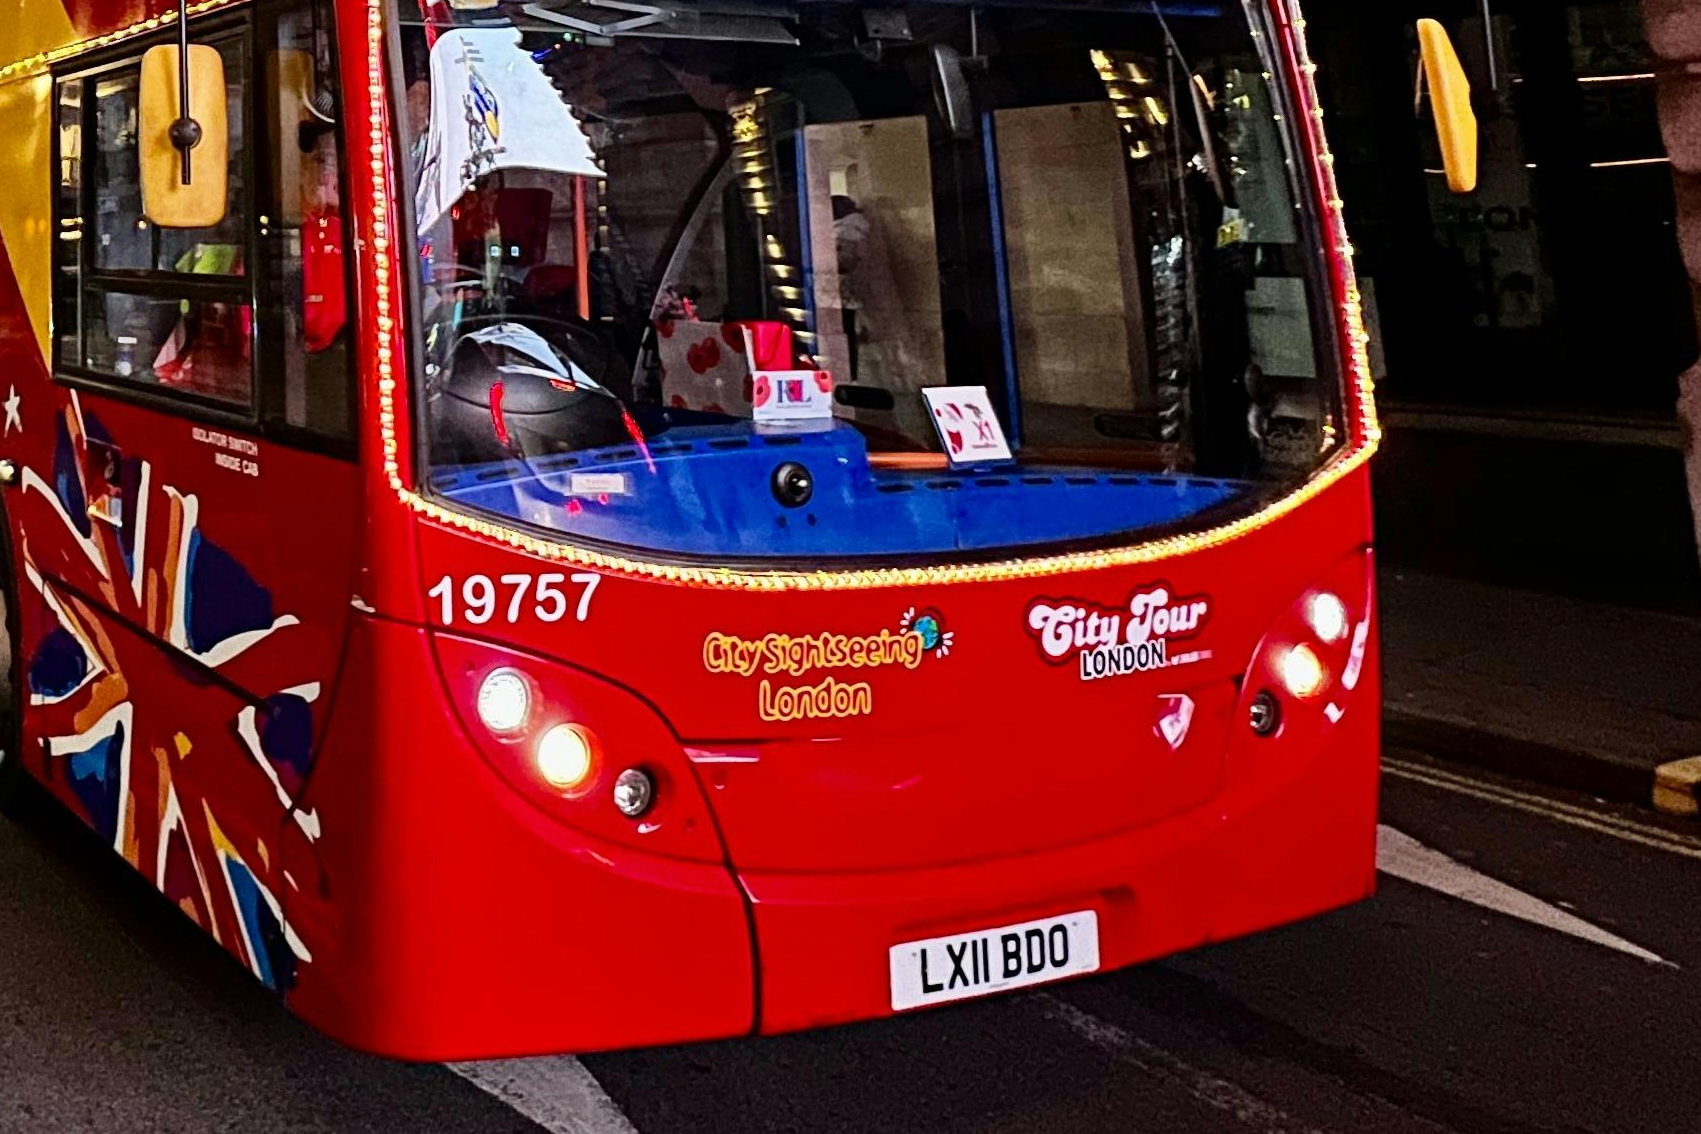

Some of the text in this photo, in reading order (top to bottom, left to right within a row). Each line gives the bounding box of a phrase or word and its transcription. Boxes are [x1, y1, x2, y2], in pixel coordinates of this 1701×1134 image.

[428, 573, 601, 626] 19757
[1029, 588, 1207, 656] City Tour
[1080, 638, 1166, 680] LONDON
[759, 677, 872, 721] London
[921, 923, 1069, 993] LX11 BDO
